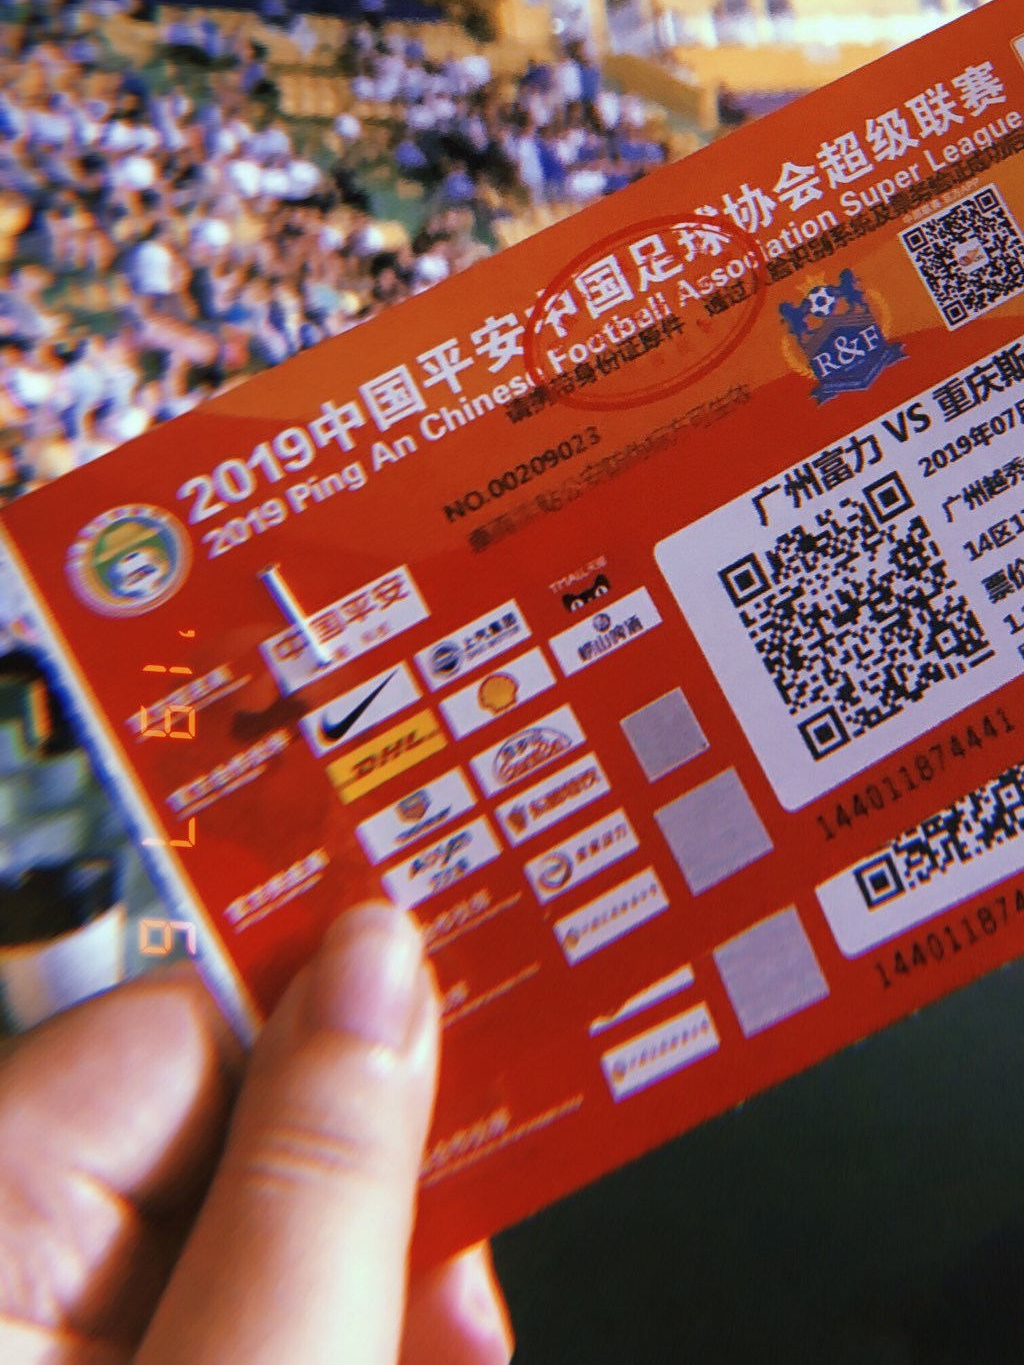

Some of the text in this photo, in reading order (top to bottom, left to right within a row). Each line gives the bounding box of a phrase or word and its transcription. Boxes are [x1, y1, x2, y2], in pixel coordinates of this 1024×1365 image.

[172, 58, 1010, 528] 2019中国平安中国足球协会超级联赛
[199, 494, 289, 560] 2019
[284, 454, 369, 515] Ping
[365, 428, 417, 472] An
[416, 360, 547, 444] Chinese
[546, 289, 672, 374] Football
[671, 202, 838, 307] Association
[837, 158, 926, 222] Super
[923, 105, 1024, 175] League
[809, 319, 885, 378] R&F
[442, 424, 602, 523] NO.00209023
[747, 425, 887, 527] 广州富力
[881, 400, 934, 447] VS
[349, 726, 431, 779] DHL
[815, 704, 1016, 841] 144011874441
